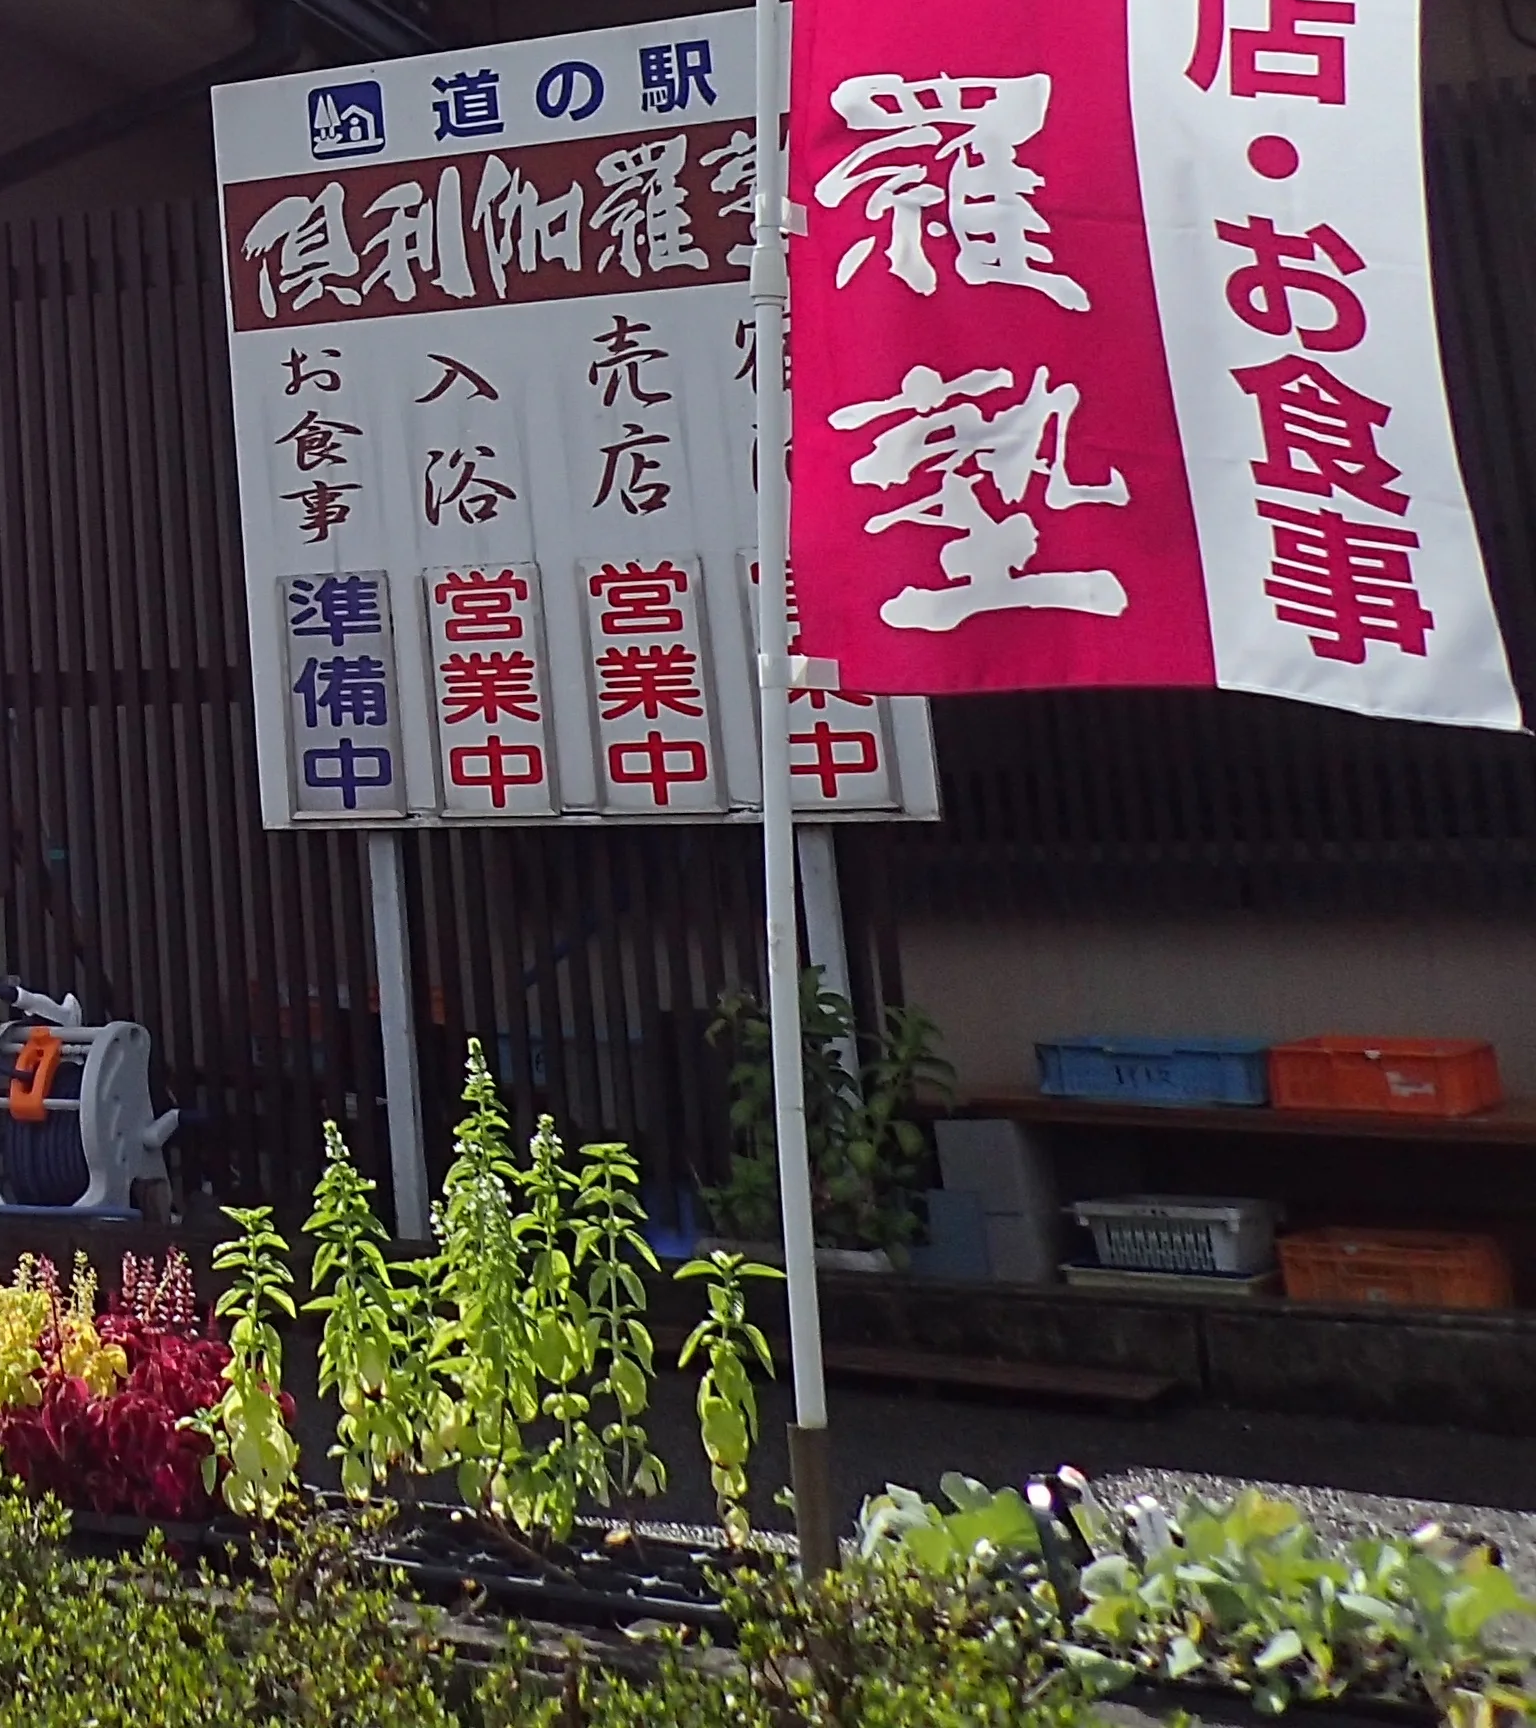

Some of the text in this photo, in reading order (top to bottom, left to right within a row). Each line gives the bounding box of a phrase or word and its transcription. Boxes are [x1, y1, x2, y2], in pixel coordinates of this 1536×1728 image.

[431, 38, 718, 142] 道の駅
[275, 347, 363, 545] お食事
[414, 353, 517, 528] 入浴
[588, 315, 673, 516] 売店
[288, 576, 392, 810] 準備中
[435, 570, 544, 809] 営業中
[588, 561, 709, 806] 営業中
